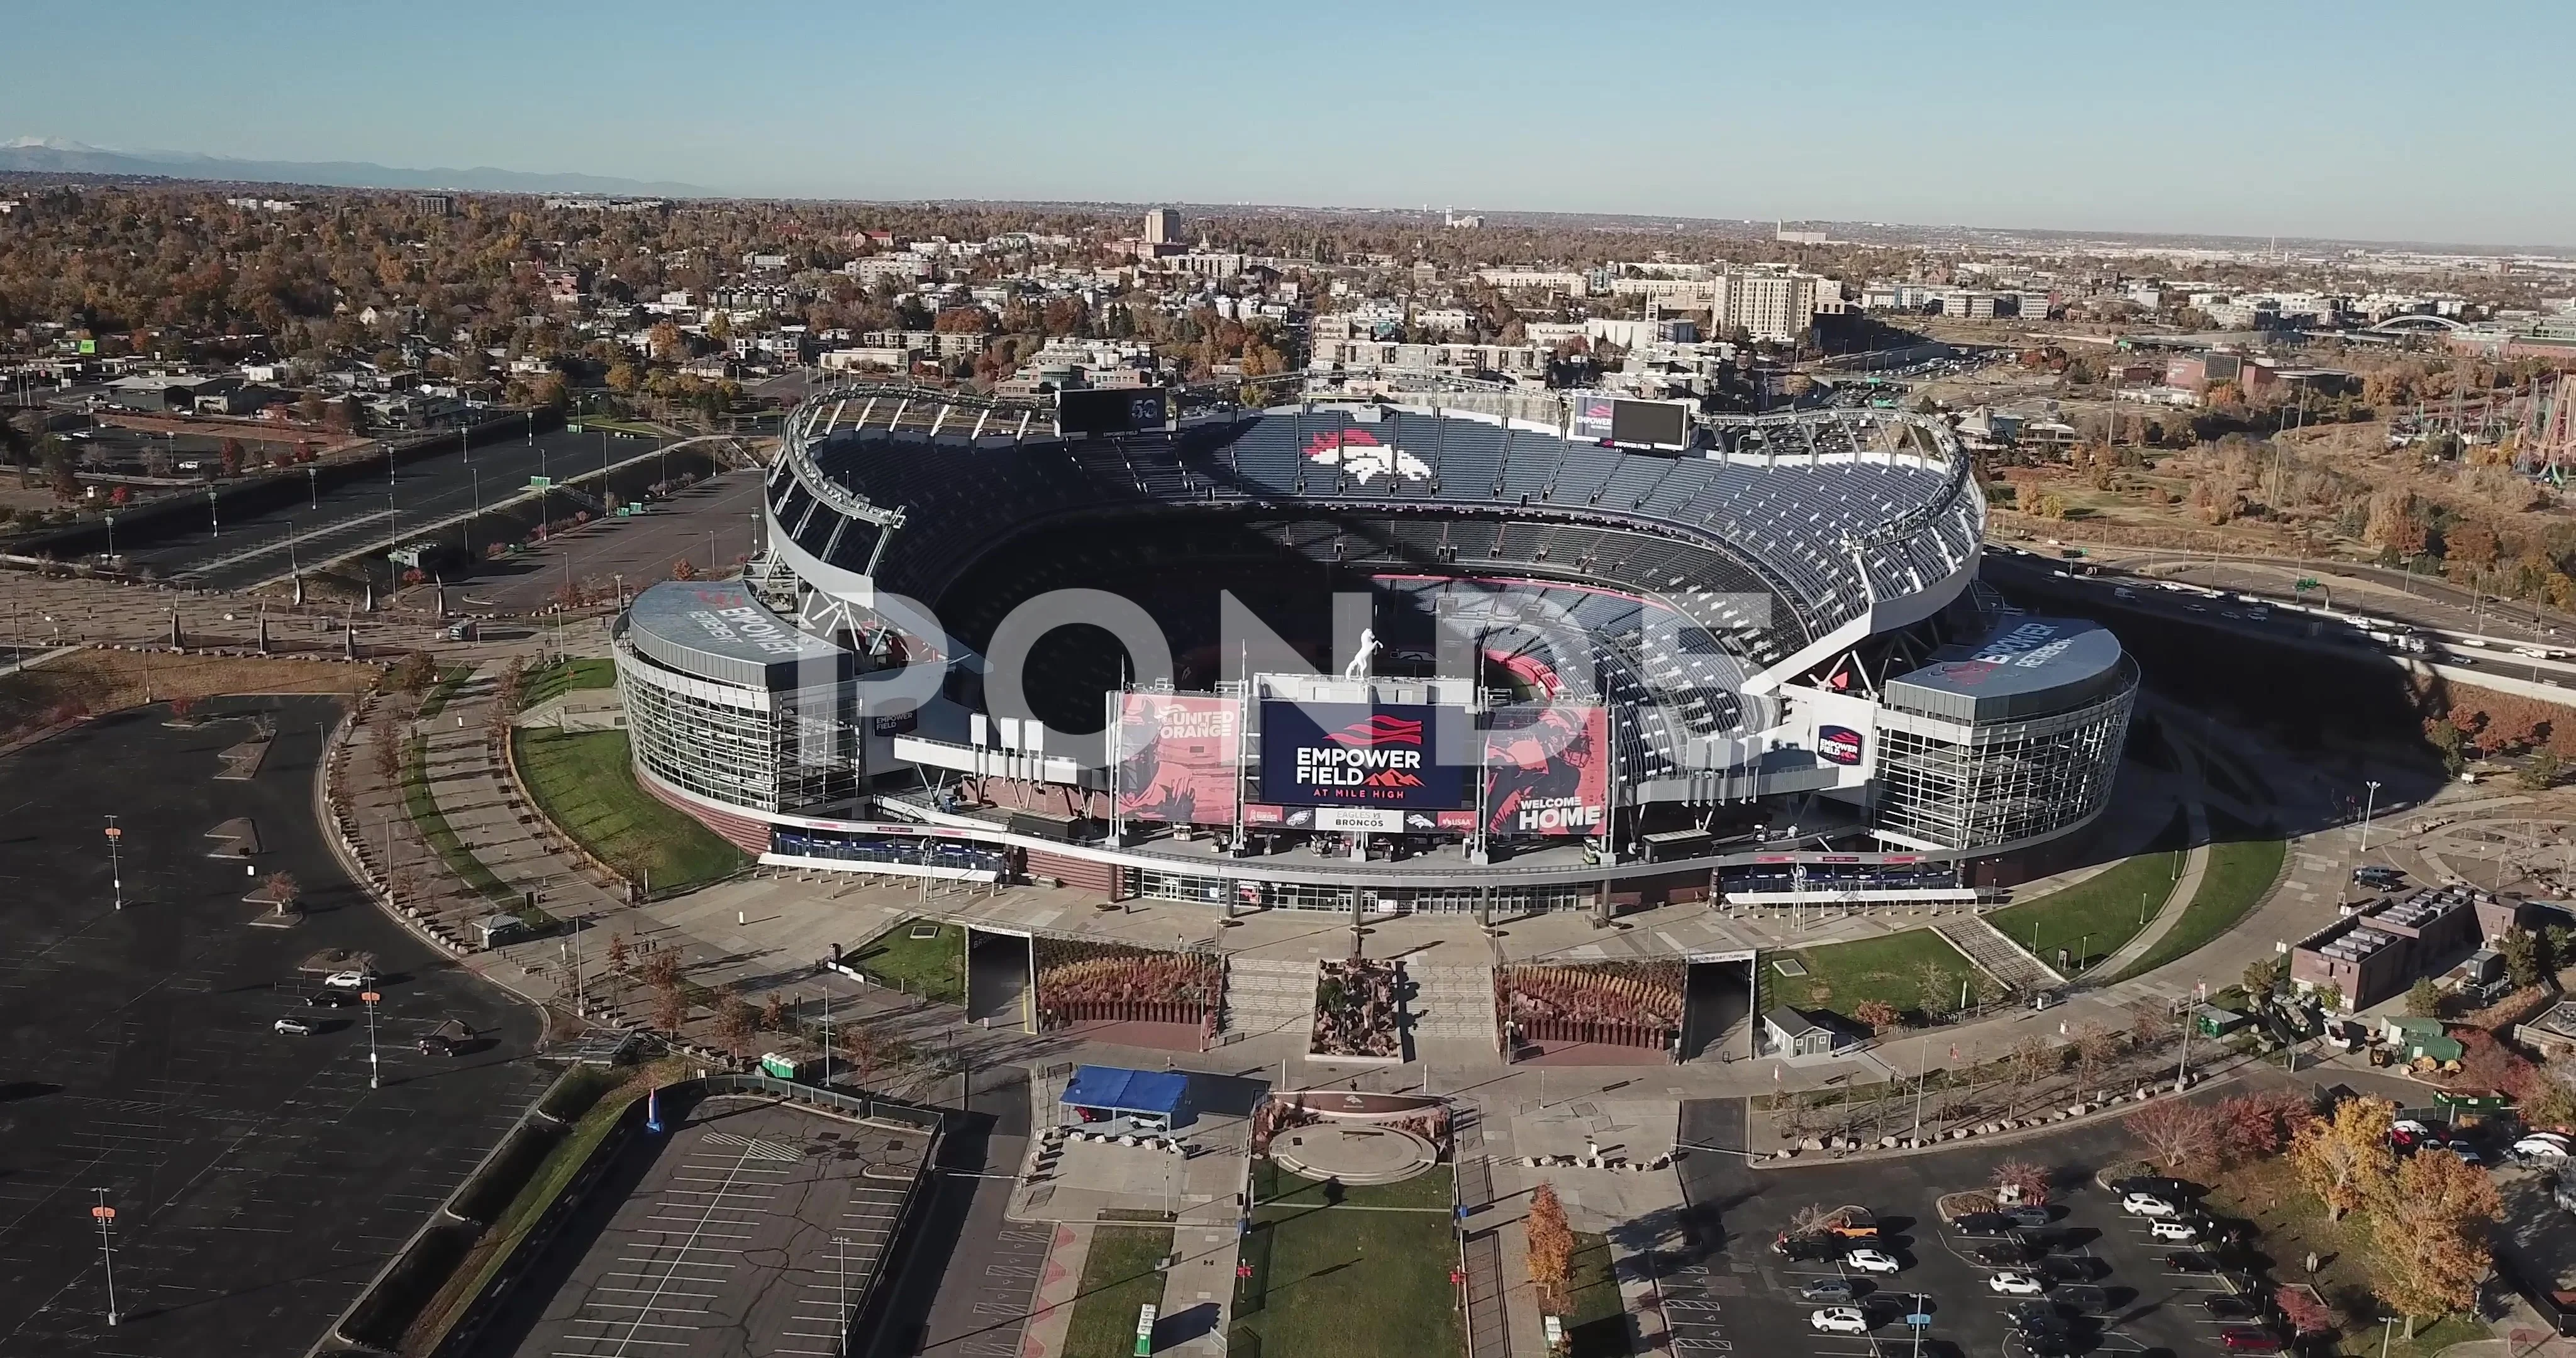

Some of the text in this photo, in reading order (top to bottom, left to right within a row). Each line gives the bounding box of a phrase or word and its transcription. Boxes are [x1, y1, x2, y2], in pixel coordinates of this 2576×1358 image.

[1575, 416, 1612, 426] EMPOWER
[717, 607, 803, 655] EMPOWER
[1970, 623, 2059, 664] EMPOWER
[876, 712, 913, 724] EMPOWER
[1173, 711, 1234, 726] UNITED
[876, 721, 897, 731] FIELD
[1160, 724, 1231, 739] ORANGE
[1819, 738, 1858, 754] EMPOWER
[1819, 746, 1840, 756] FIELD
[1297, 747, 1421, 769] EMPOWER
[1296, 766, 1364, 785] FIELD
[1313, 788, 1404, 799] AT MILE HIGH
[1521, 797, 1582, 809] WELCOME
[1519, 805, 1601, 830] HOME
